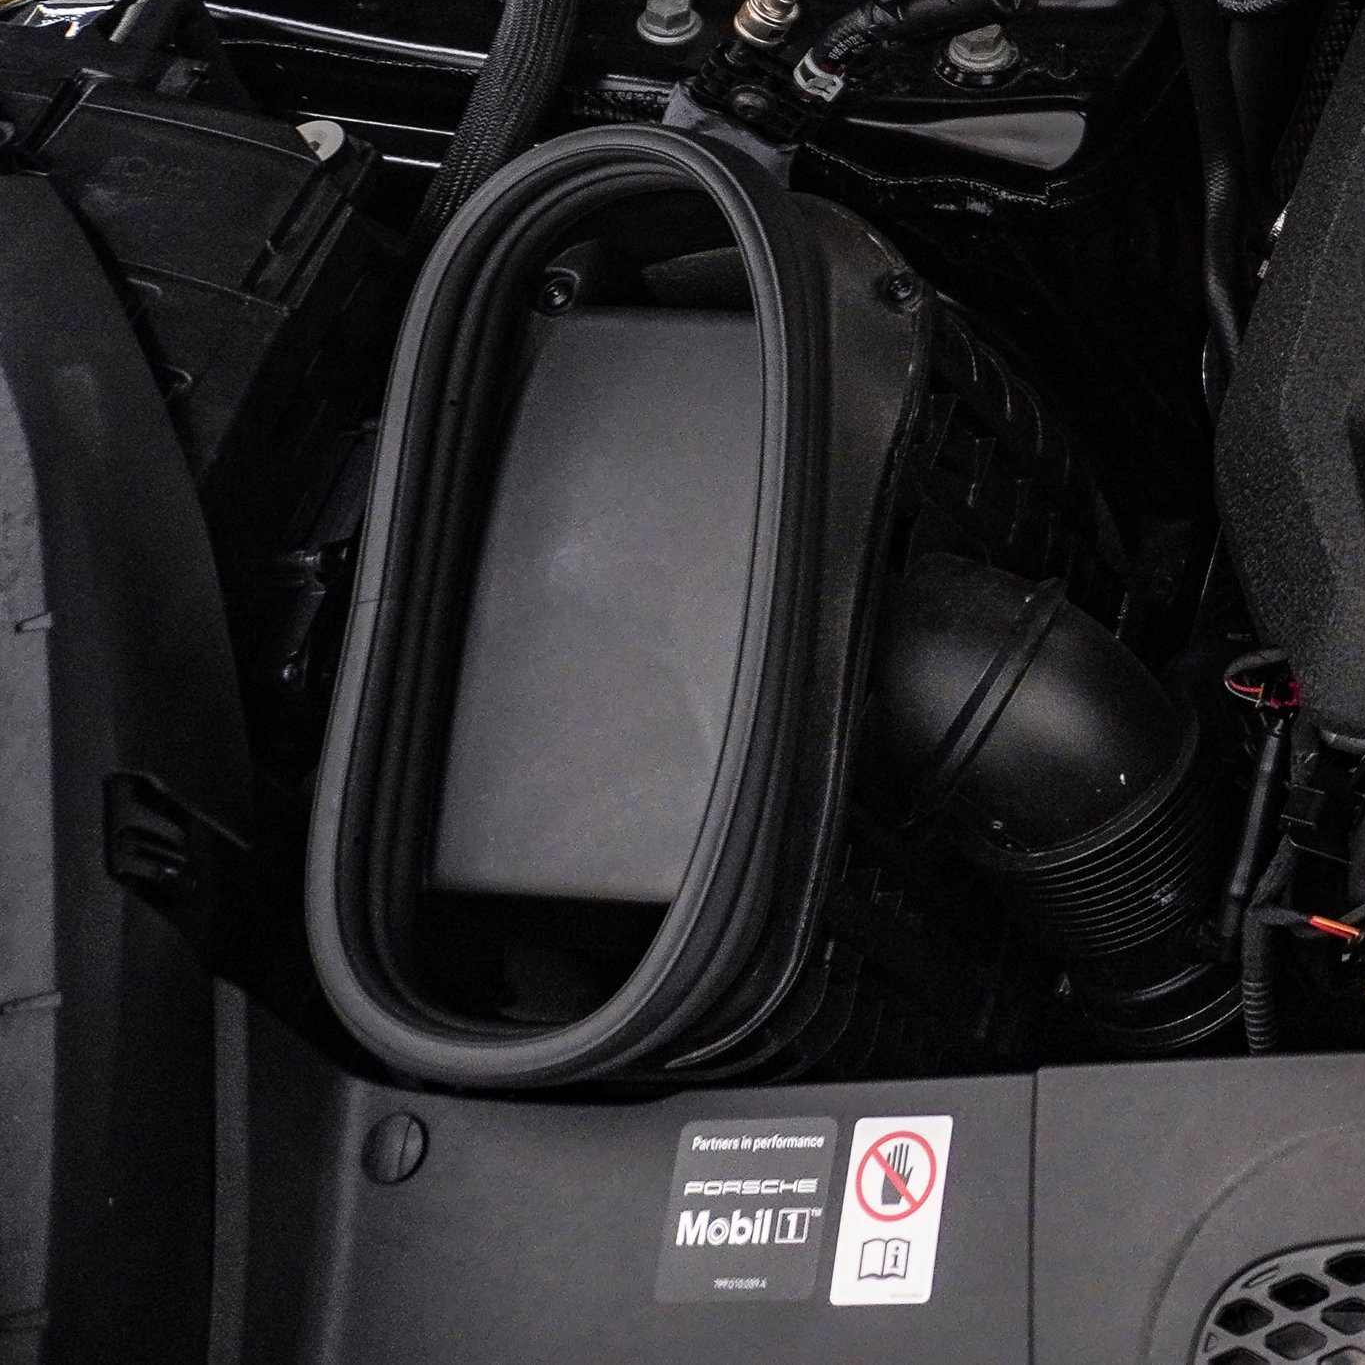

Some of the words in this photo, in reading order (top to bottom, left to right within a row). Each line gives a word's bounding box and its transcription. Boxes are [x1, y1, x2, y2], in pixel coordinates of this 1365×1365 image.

[692, 1135, 740, 1151] Partners
[741, 1134, 752, 1149] in
[753, 1134, 825, 1153] performance
[684, 1178, 820, 1196] PORSCHE
[675, 1208, 773, 1246] Mobil
